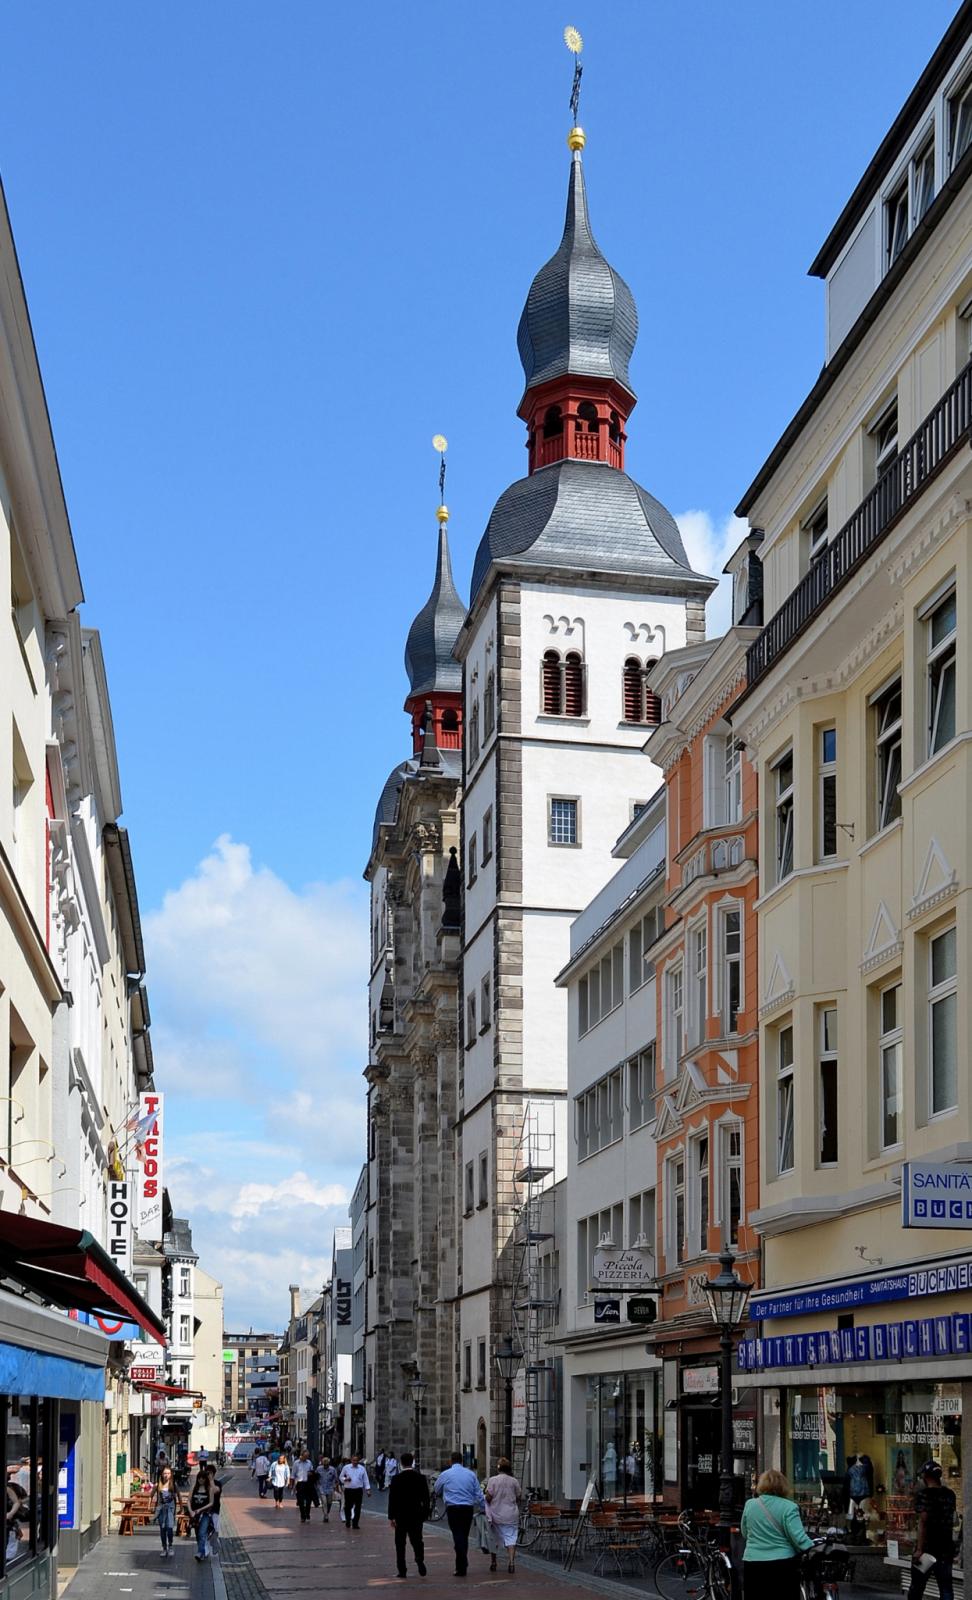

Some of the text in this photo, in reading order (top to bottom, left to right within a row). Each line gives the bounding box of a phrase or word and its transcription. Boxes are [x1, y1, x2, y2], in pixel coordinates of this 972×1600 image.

[144, 1096, 159, 1198] TACOS
[913, 1171, 972, 1189] SANITÄ
[110, 1183, 128, 1275] HOTE
[603, 1259, 643, 1270] Piccola
[620, 1251, 634, 1262] La
[598, 1270, 650, 1279] PIZZERIA
[756, 1265, 972, 1316] Der Partner für Ihre Gesundheit SANITÄTSHAUS BÜCHNE
[337, 1278, 352, 1326] KULT
[794, 1414, 823, 1430] 80 JAHR
[904, 1414, 944, 1434] 80 JAHRE
